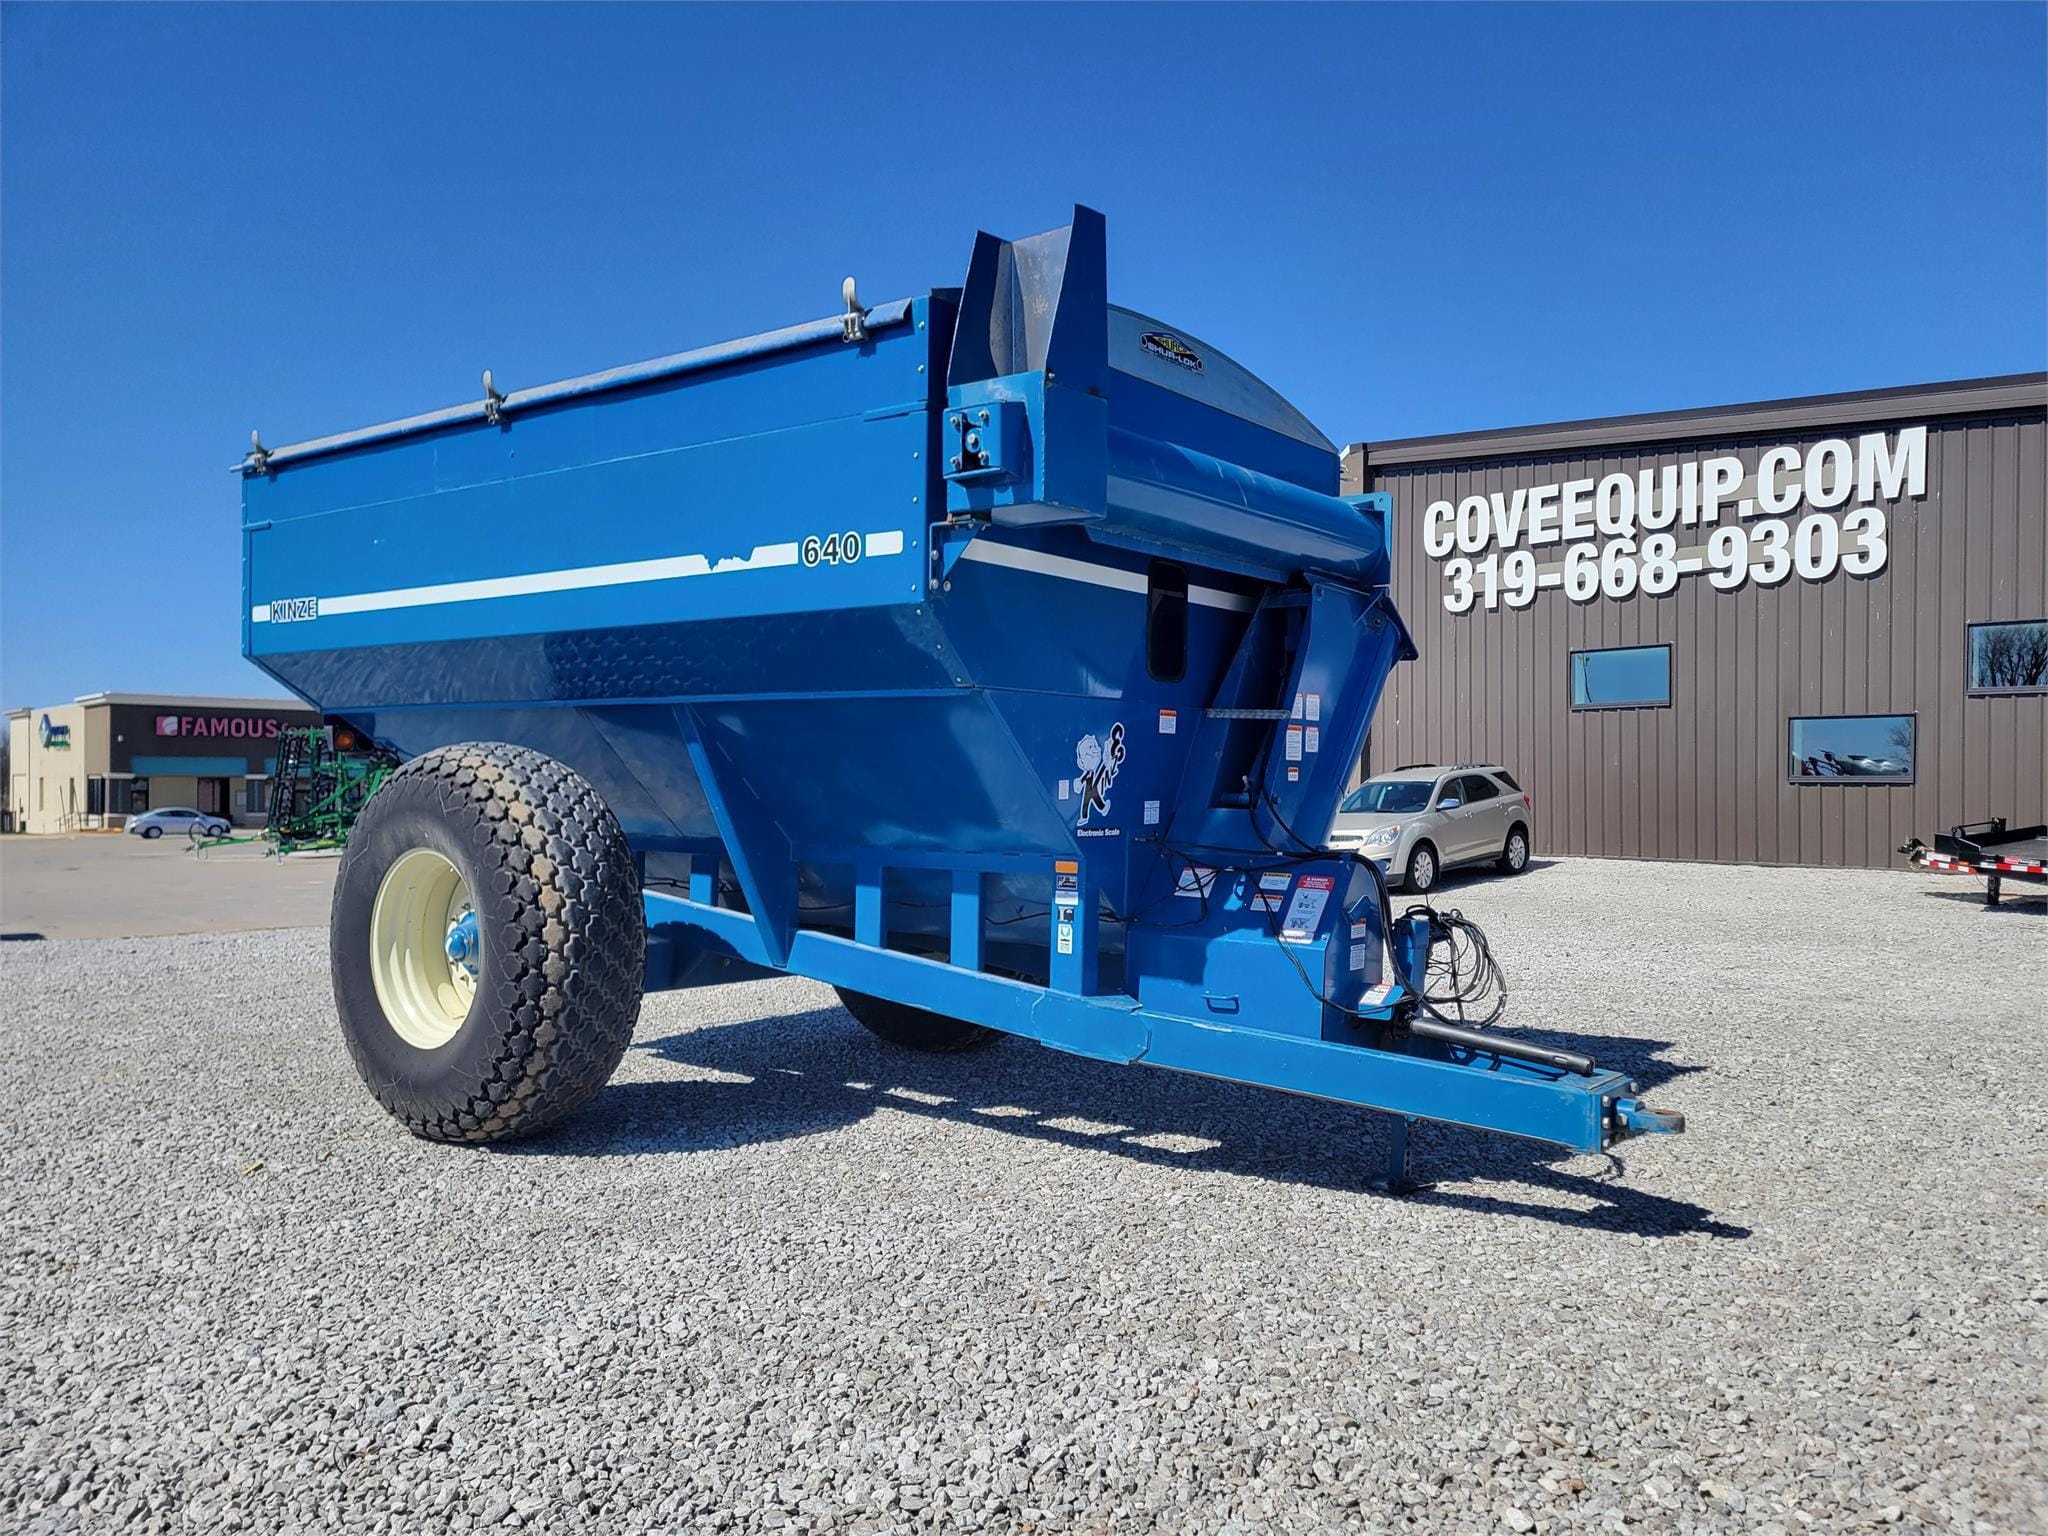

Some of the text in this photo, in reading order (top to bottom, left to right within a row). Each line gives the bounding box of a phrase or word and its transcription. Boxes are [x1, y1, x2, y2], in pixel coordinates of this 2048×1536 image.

[1423, 426, 1928, 558] COVEEQUIP.COM
[802, 531, 861, 567] 640
[1443, 507, 1888, 613] 319-668-9303
[271, 596, 317, 623] KINZE
[181, 716, 278, 738] FAMOUS
[1077, 827, 1121, 837] Electronic Scale
